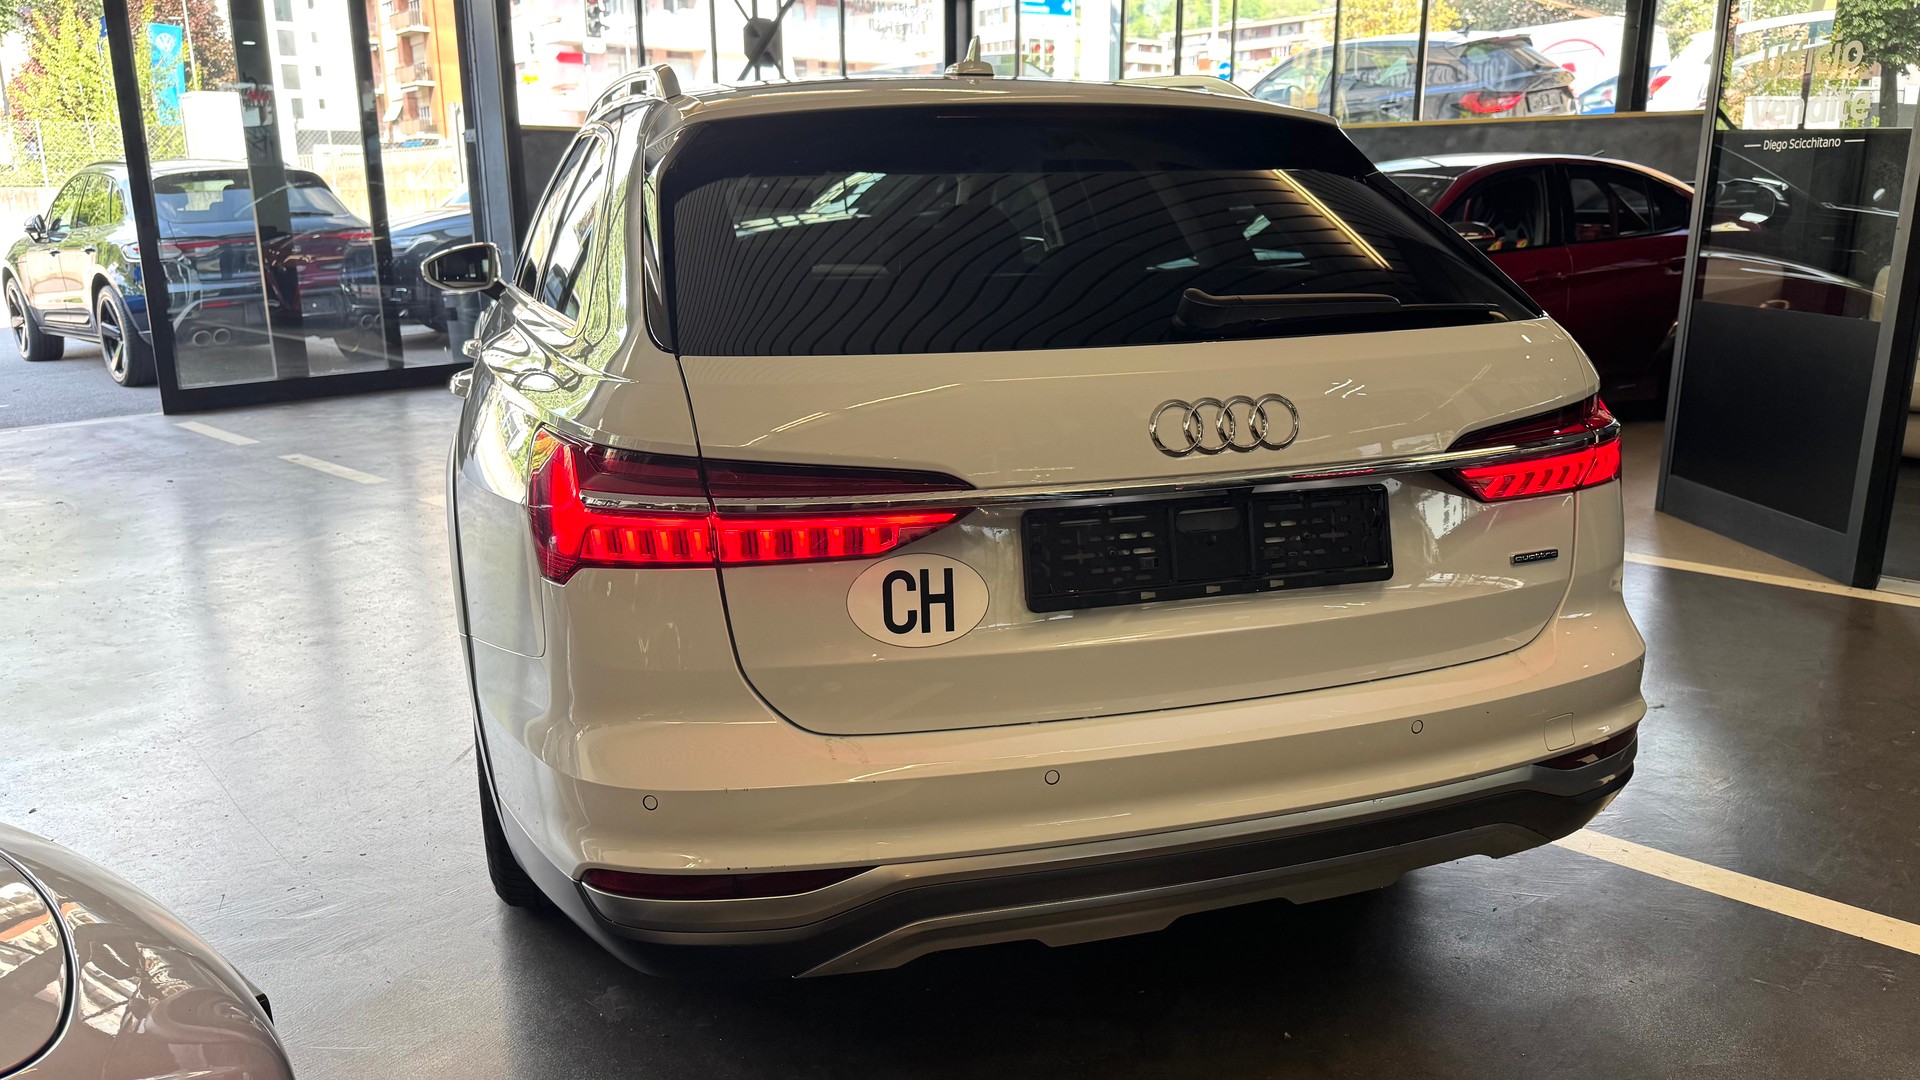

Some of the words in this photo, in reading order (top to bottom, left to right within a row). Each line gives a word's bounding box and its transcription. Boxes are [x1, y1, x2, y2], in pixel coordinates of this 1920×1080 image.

[1751, 86, 1871, 127] vendite
[1763, 139, 1788, 153] Diego
[1789, 137, 1841, 150] Scicchitano
[1515, 551, 1557, 561] quattro
[882, 568, 955, 634] CH
